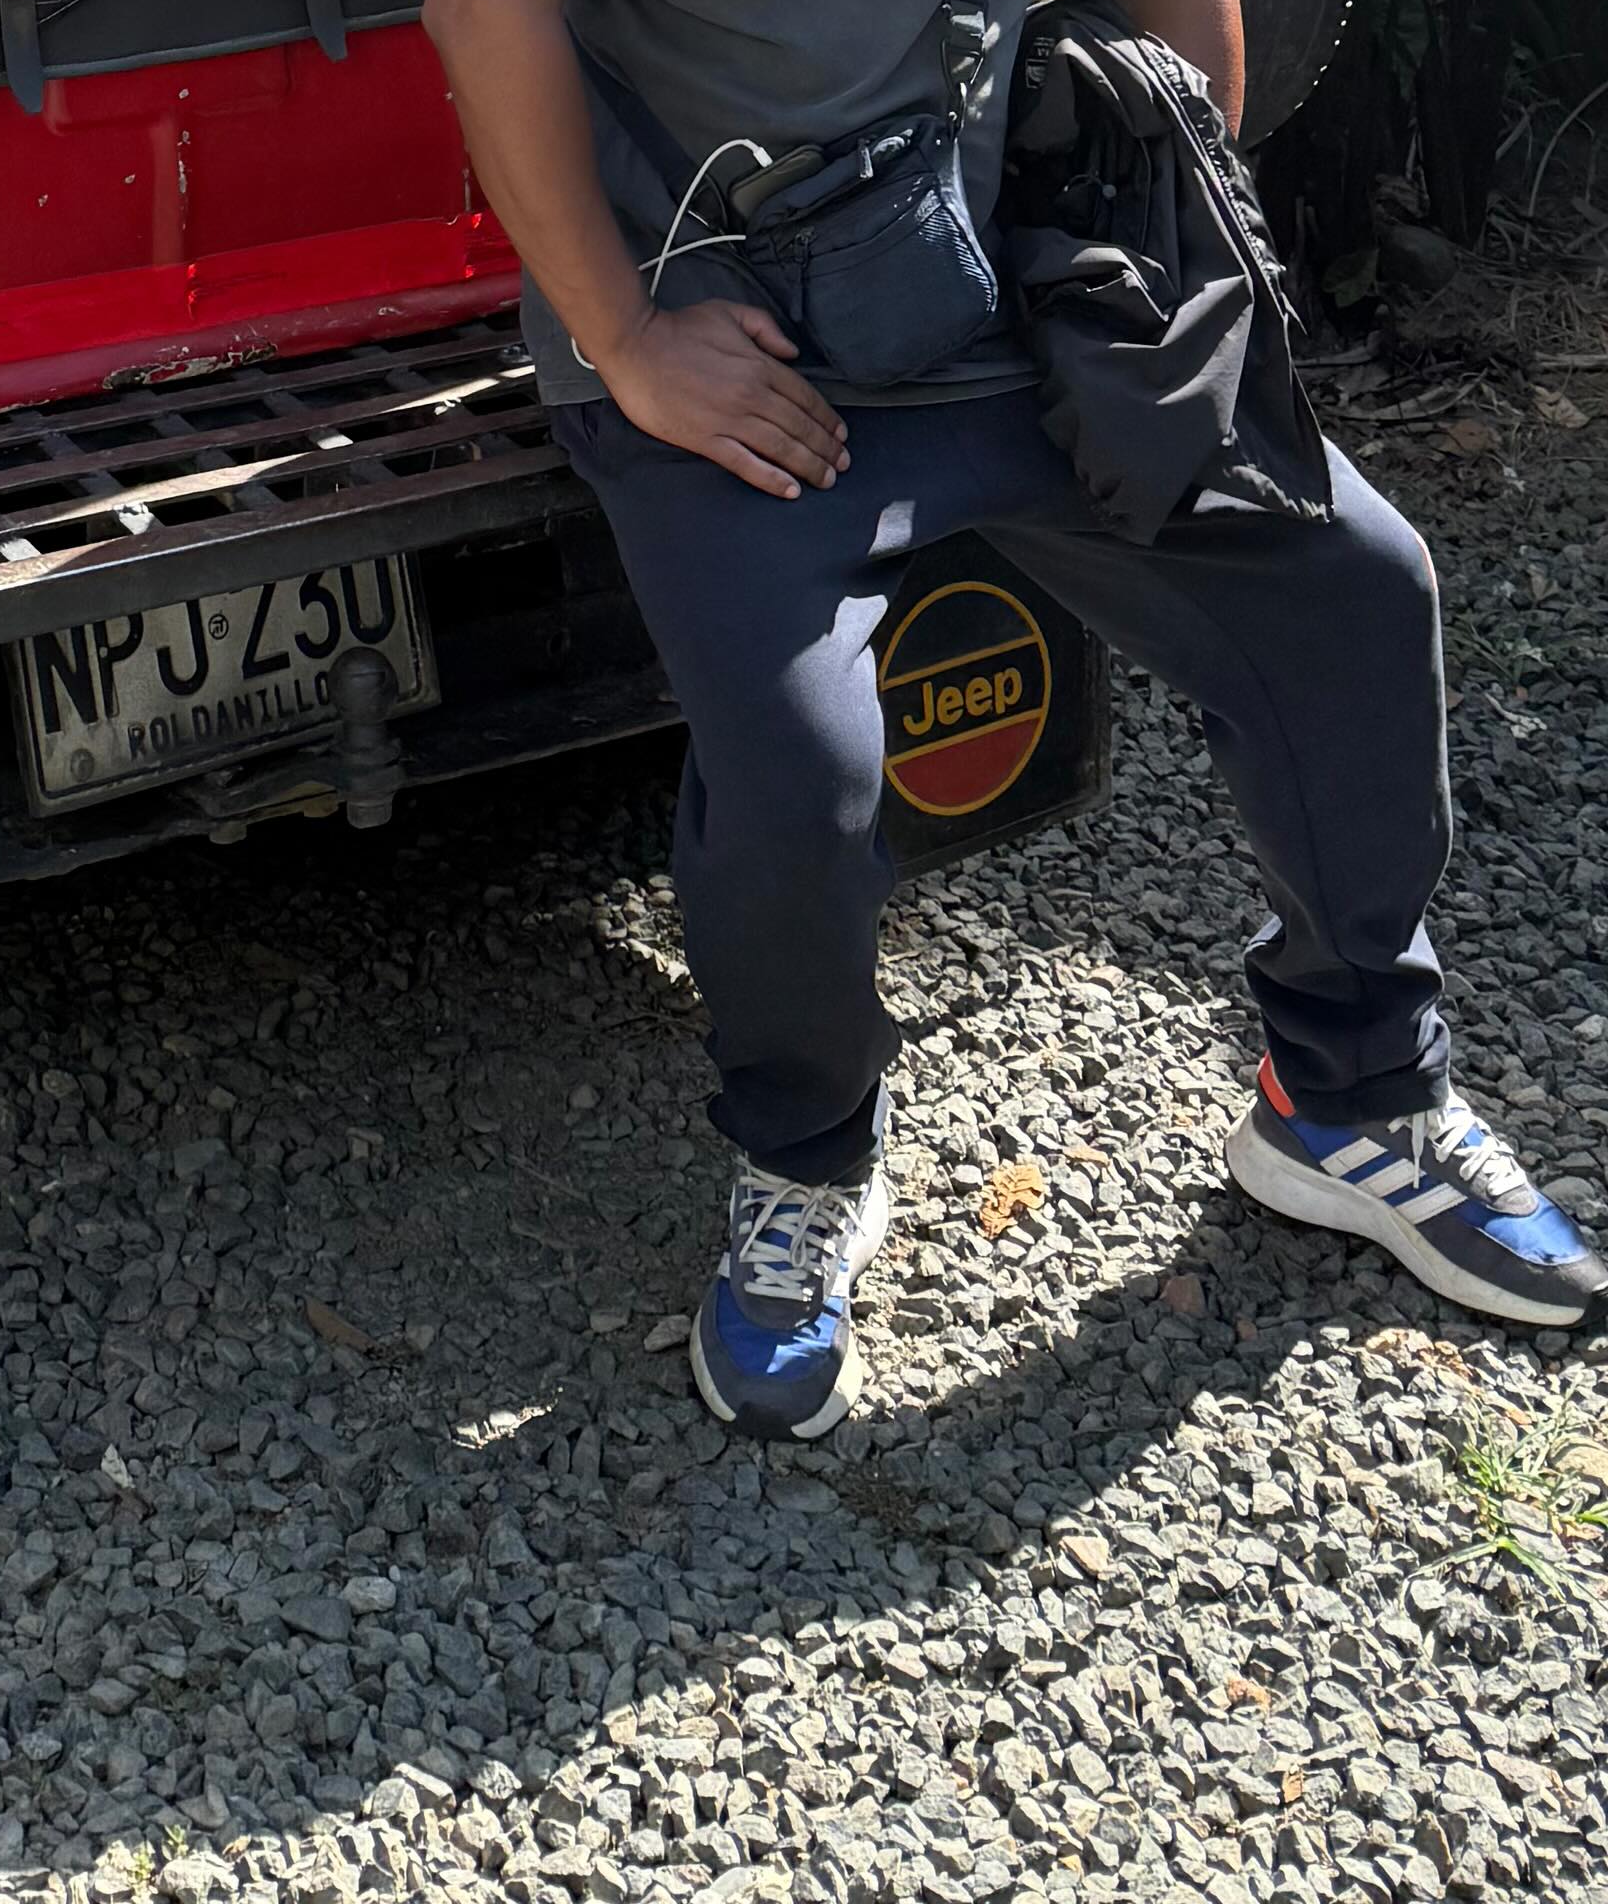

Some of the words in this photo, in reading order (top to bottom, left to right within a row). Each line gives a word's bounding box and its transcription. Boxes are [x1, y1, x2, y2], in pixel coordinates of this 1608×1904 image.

[31, 598, 209, 734] NPJ
[902, 666, 1023, 736] Jeep
[127, 670, 330, 762] ROLDANILLO
